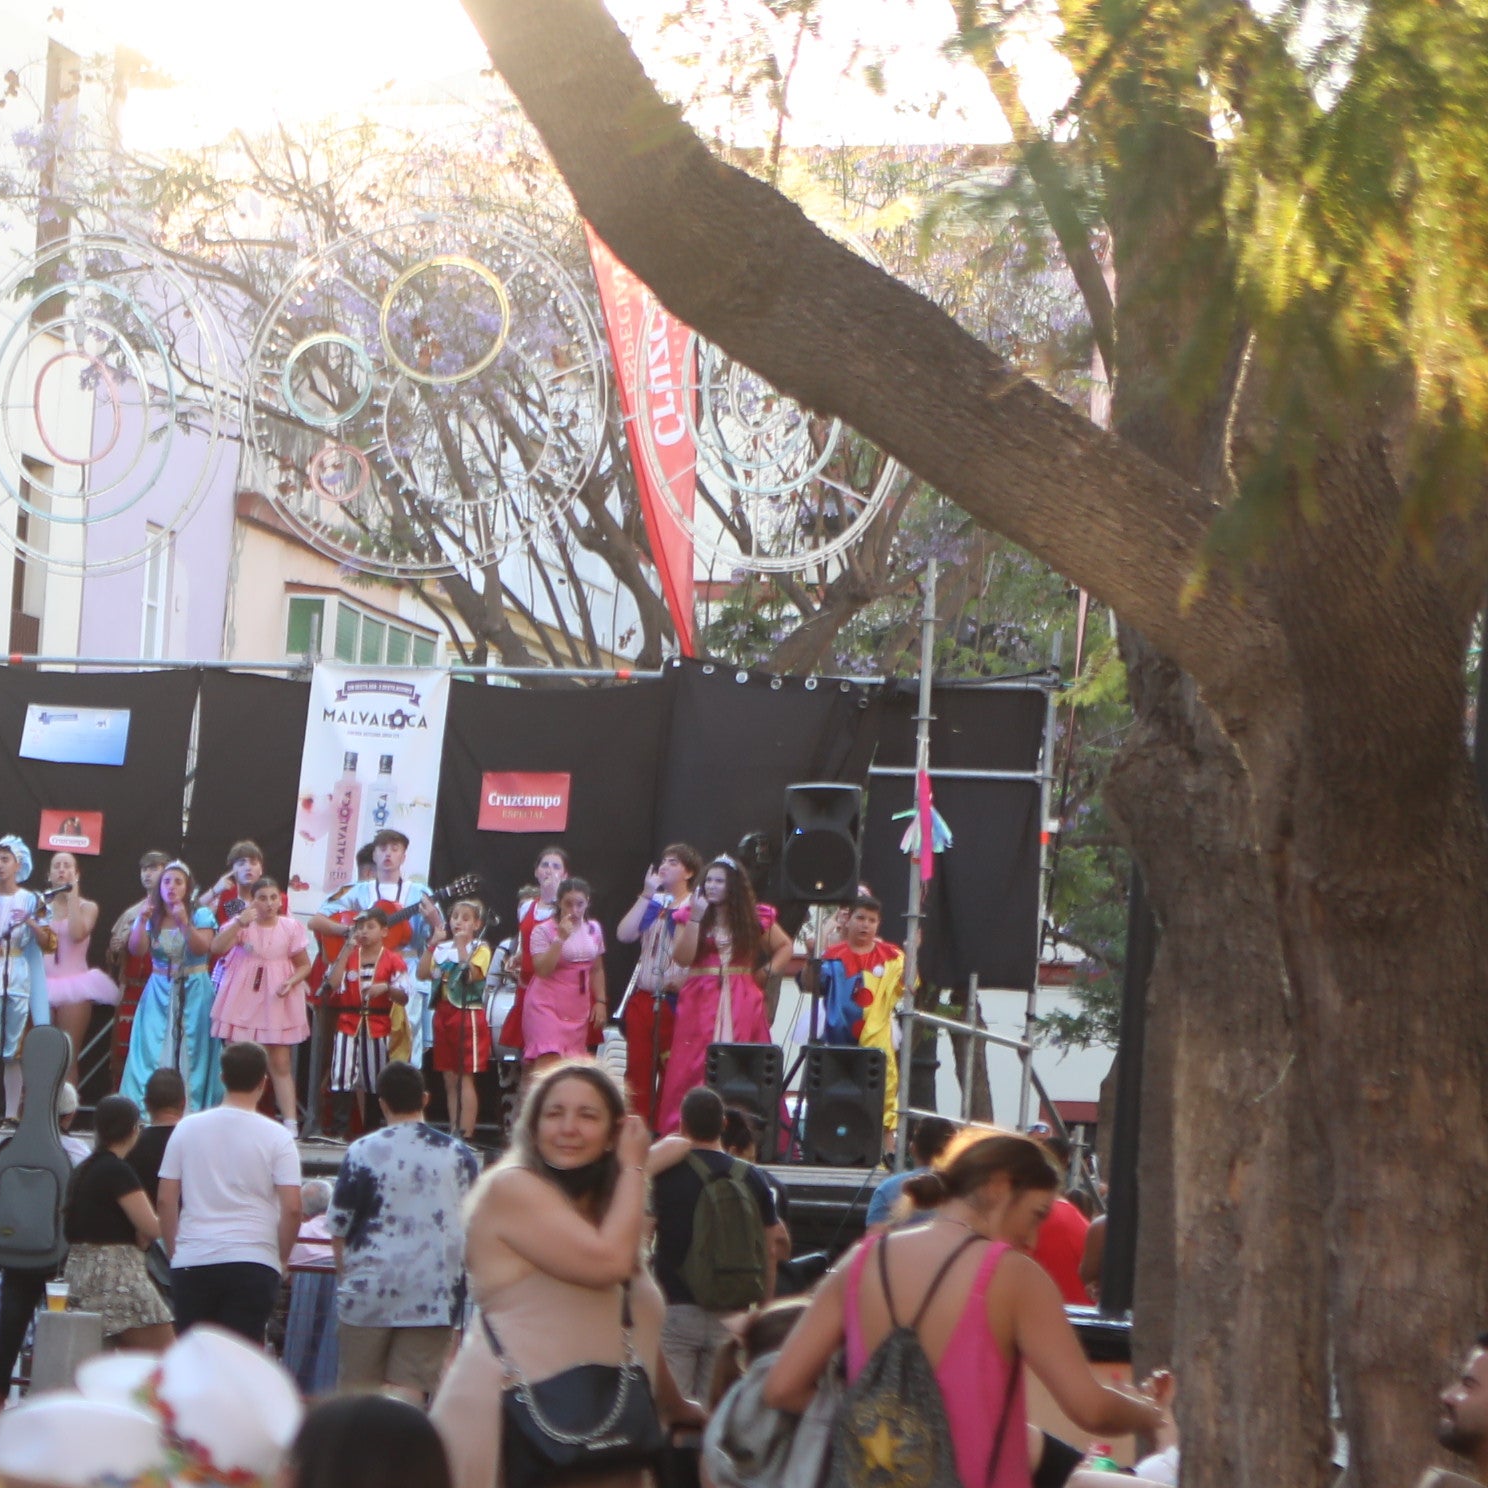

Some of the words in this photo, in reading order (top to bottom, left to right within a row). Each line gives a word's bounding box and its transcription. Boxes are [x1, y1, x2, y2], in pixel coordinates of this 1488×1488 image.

[323, 708, 428, 729] MALVALOCA
[487, 791, 562, 810] Cruzcampo
[336, 791, 352, 866] MALVALOCA
